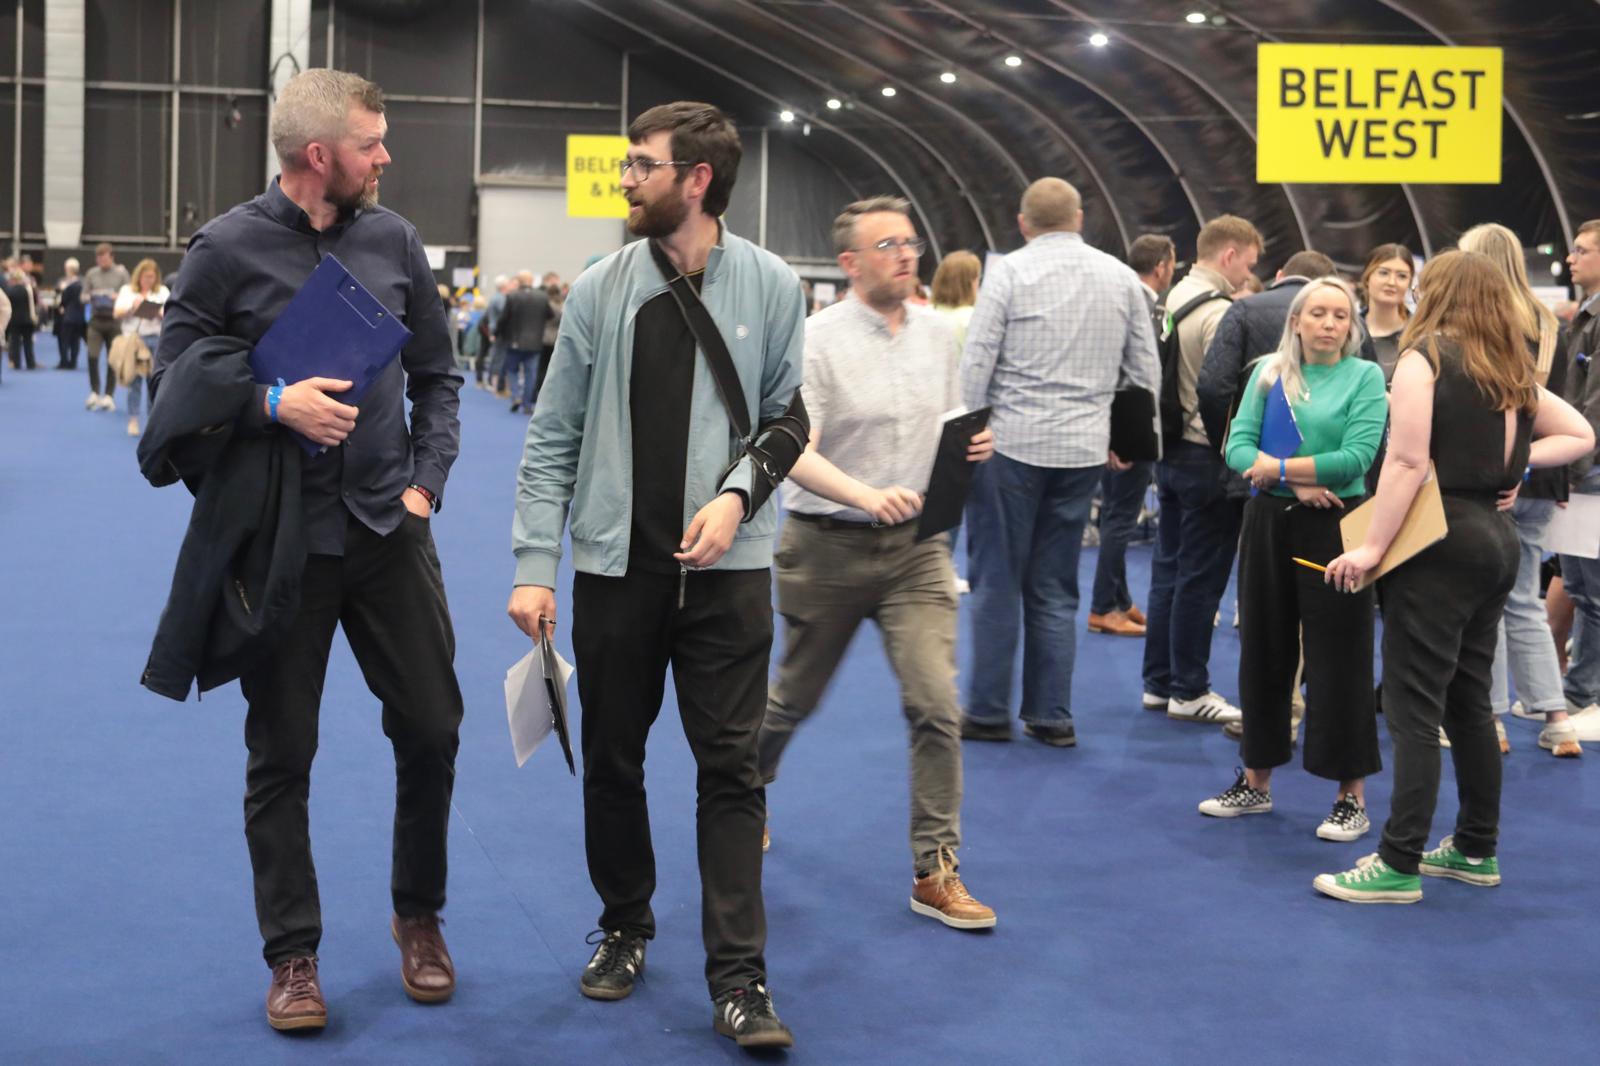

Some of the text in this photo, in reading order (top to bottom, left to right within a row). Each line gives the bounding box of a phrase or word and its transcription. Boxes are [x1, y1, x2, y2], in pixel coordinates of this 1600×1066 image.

[1280, 68, 1486, 110] BELFAST
[1316, 119, 1447, 159] WEST
[574, 156, 621, 174] BELF
[591, 182, 603, 197] &
